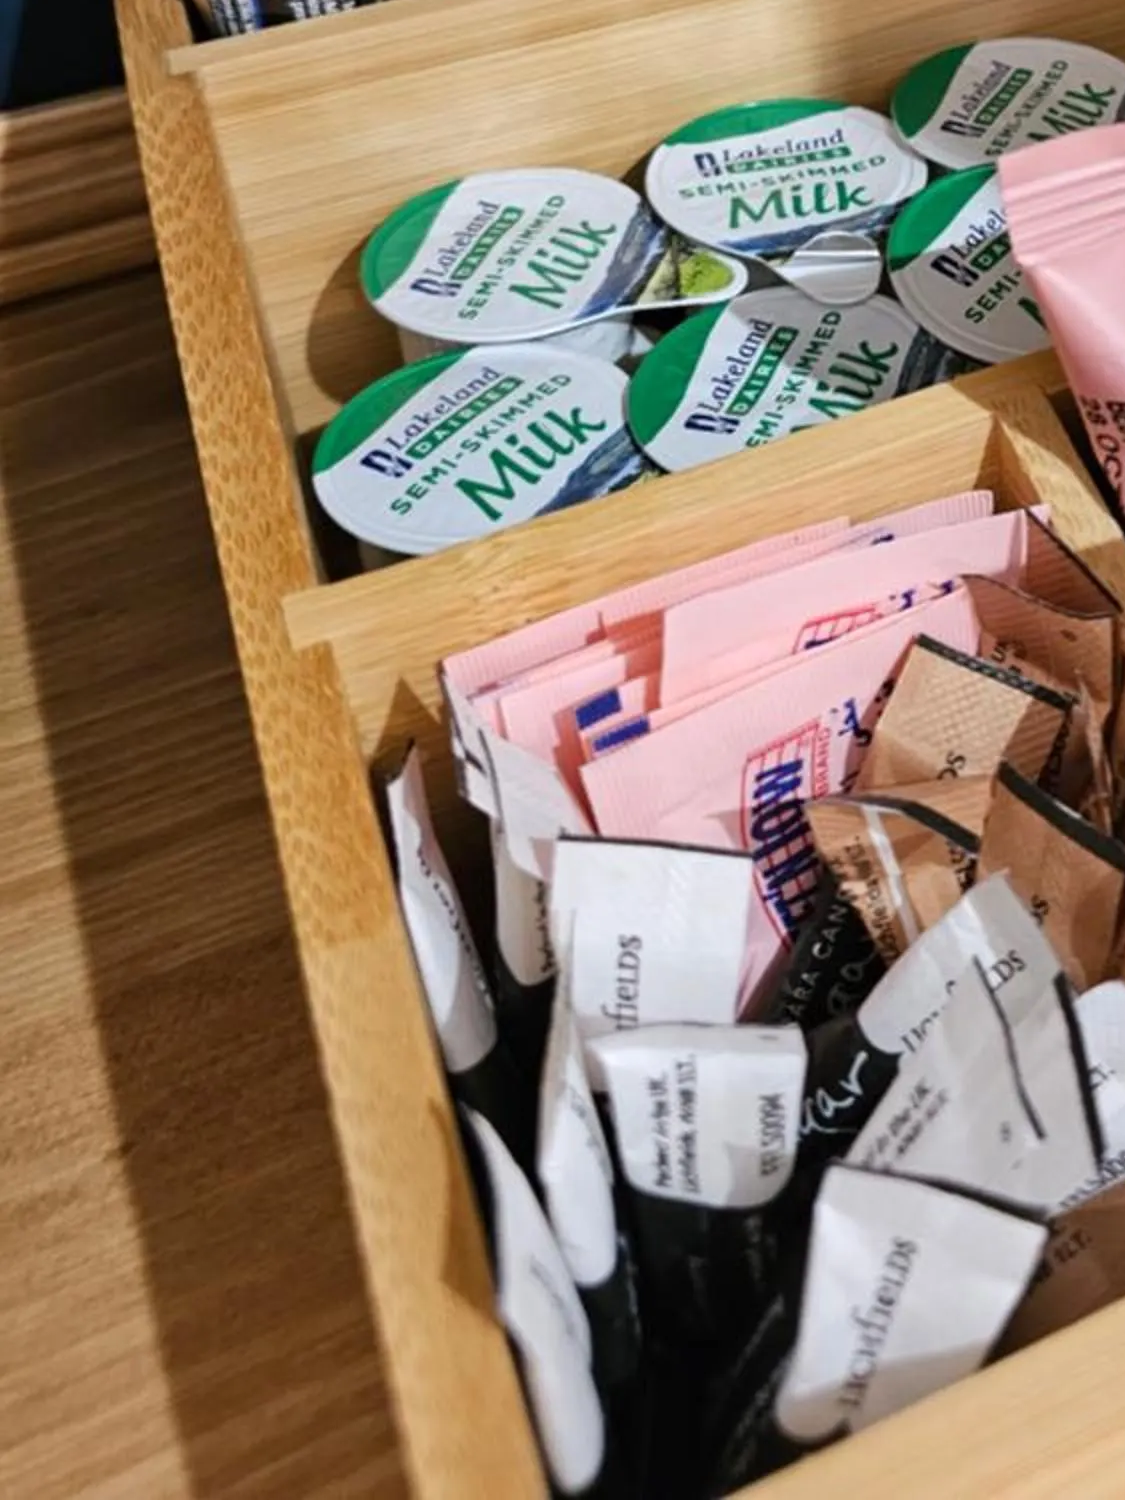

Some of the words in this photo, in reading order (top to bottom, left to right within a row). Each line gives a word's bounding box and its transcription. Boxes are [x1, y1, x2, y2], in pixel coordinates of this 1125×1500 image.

[678, 154, 887, 199] SEMI-SKIMMED
[723, 127, 845, 162] Lakeland
[424, 199, 500, 277] Lakeland
[729, 180, 874, 229] Milk
[949, 208, 1007, 260] Lakel
[457, 194, 566, 321] SEMI-SKIMMED
[508, 220, 617, 310] Milk
[964, 269, 1023, 324] SEMI-
[698, 317, 775, 413] Lakeland
[732, 327, 796, 416] DAIRIES
[745, 310, 843, 448] EMI-SKIMMED
[385, 366, 503, 451] Lakeland
[389, 373, 572, 516] SEMI-SKIMMED
[411, 377, 521, 457] DAIRIES
[454, 406, 608, 522] Milk
